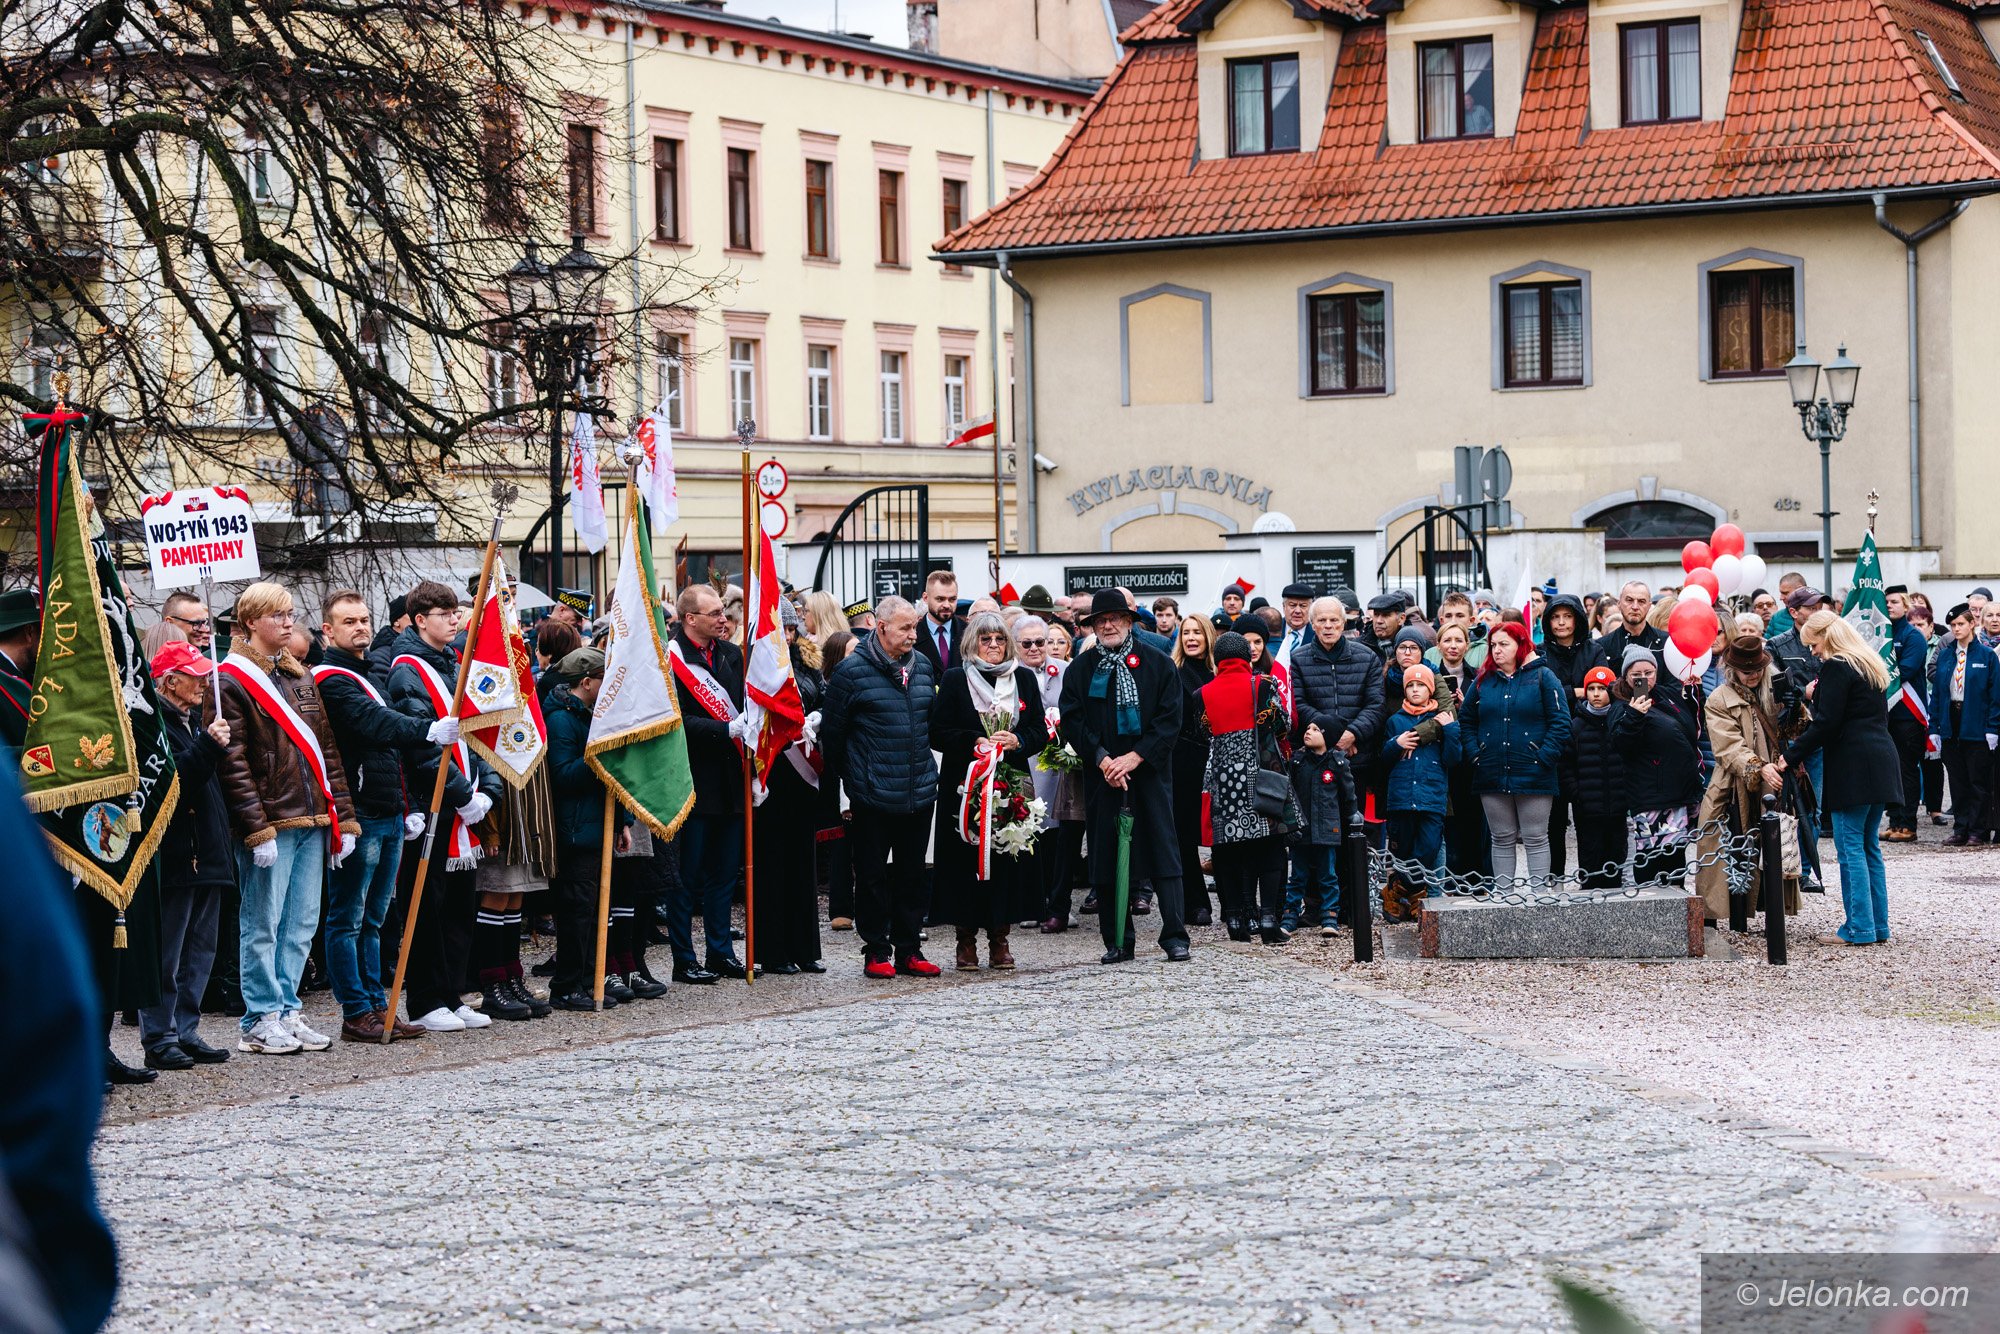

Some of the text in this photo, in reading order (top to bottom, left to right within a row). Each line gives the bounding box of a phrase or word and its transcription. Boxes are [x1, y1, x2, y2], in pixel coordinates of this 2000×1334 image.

[1066, 465, 1273, 517] KWIACIARNIA
[211, 514, 248, 537] 1943
[160, 539, 244, 568] PAMIĘTAMY
[1114, 570, 1185, 588] NIEPODLEGŁOŚCI
[48, 573, 78, 660] RADA
[704, 677, 719, 693] NSZZ
[28, 676, 64, 728] ŁO
